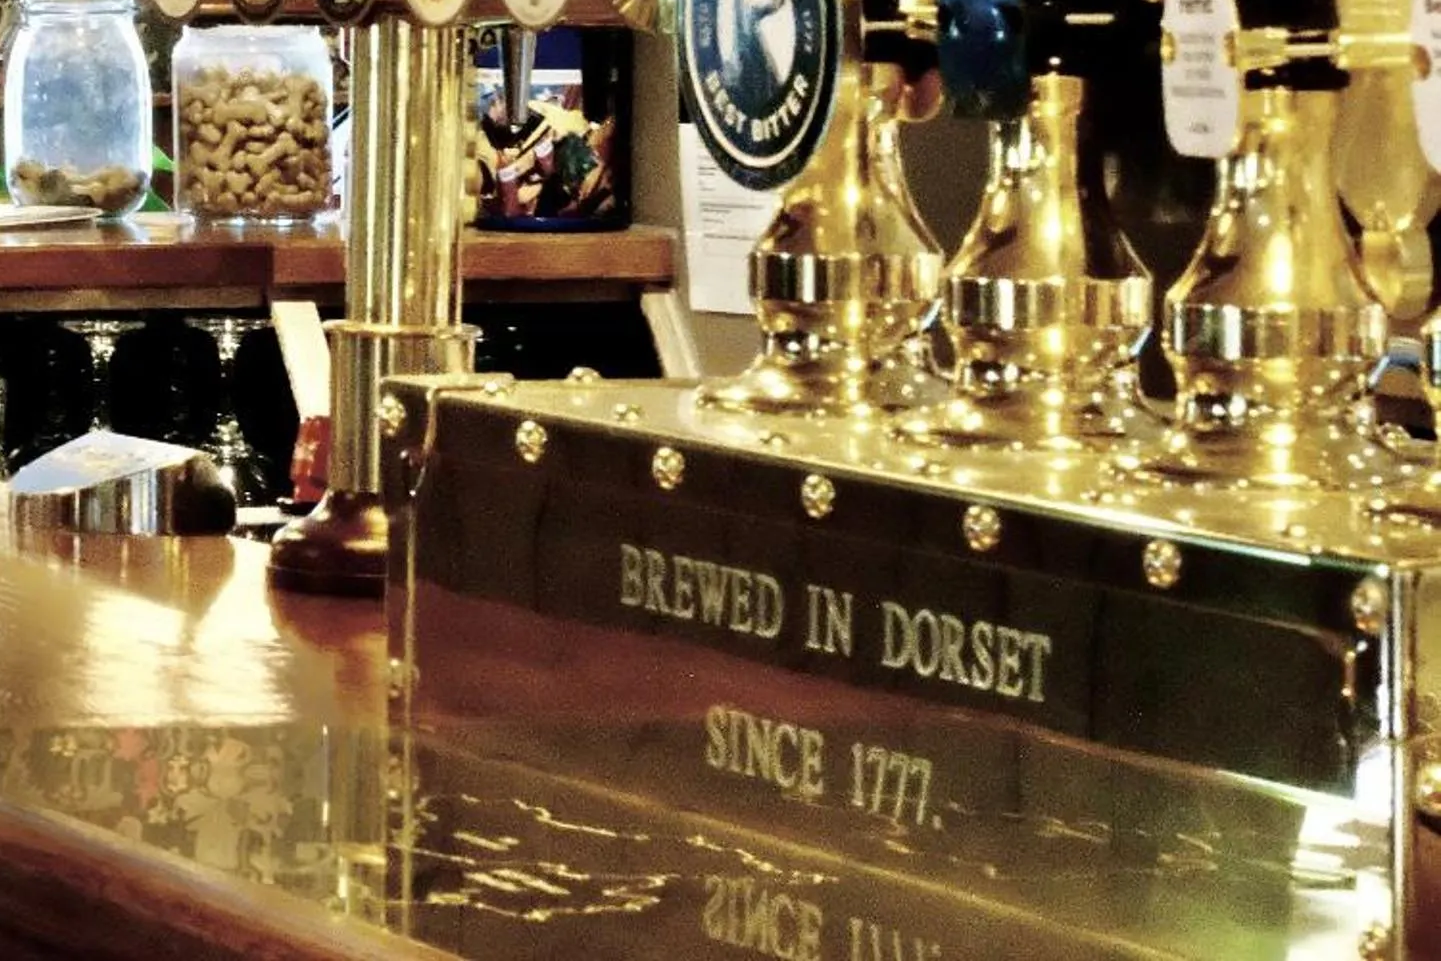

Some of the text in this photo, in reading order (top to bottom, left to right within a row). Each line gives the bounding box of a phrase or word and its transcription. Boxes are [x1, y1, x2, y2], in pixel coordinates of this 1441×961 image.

[705, 70, 810, 142] BEST BITTER
[620, 543, 1052, 703] BREWED IN DORSET
[707, 704, 825, 797] SINCE
